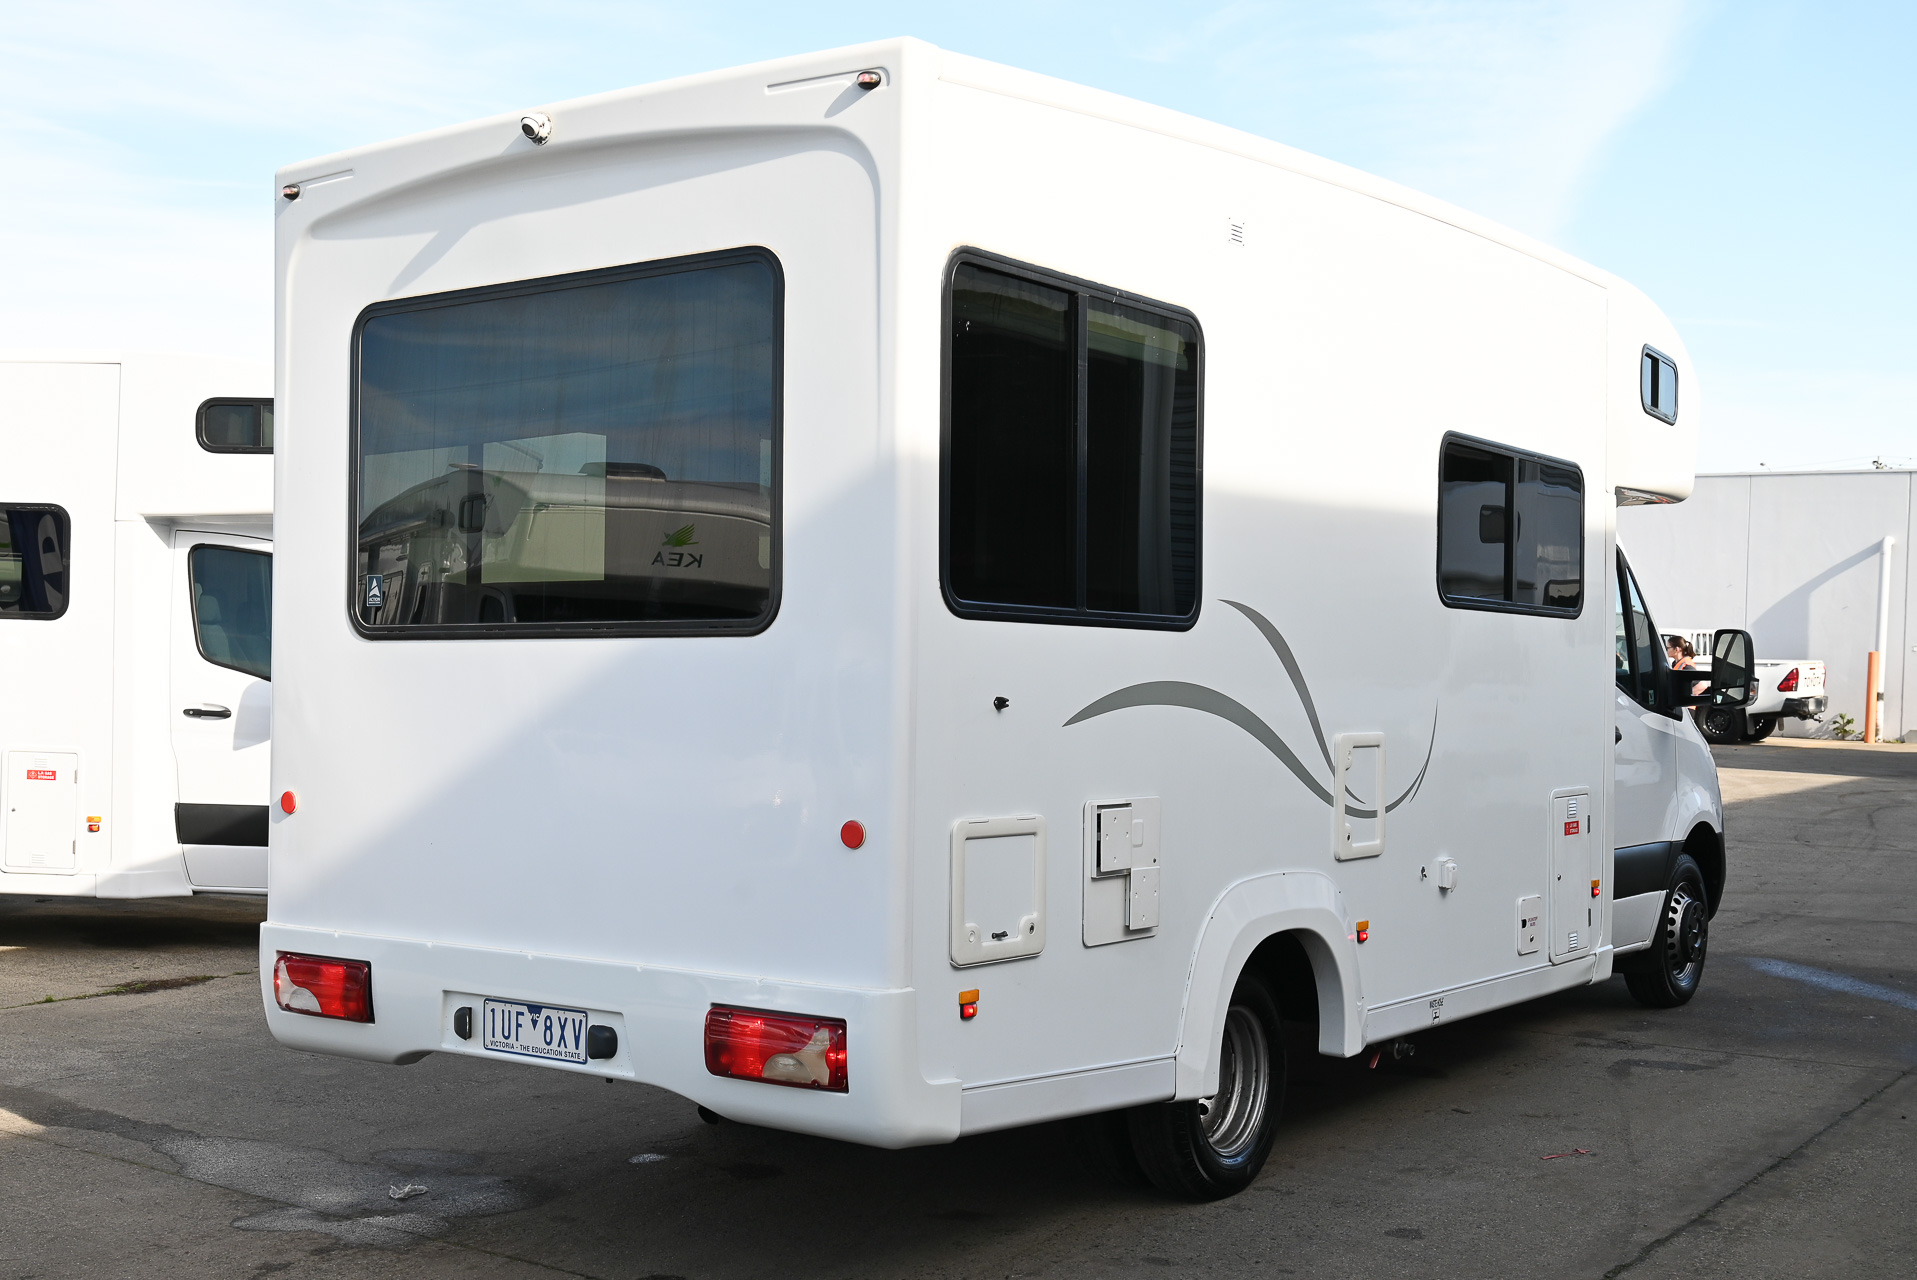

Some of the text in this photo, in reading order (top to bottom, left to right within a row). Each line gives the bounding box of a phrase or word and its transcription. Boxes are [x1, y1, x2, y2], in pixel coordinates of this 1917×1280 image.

[490, 1007, 583, 1051] 1UF 8XV
[489, 1039, 515, 1050] VICTORIA
[520, 1044, 530, 1052] THE
[531, 1046, 563, 1057] EDUCATION
[563, 1050, 581, 1059] STATE
